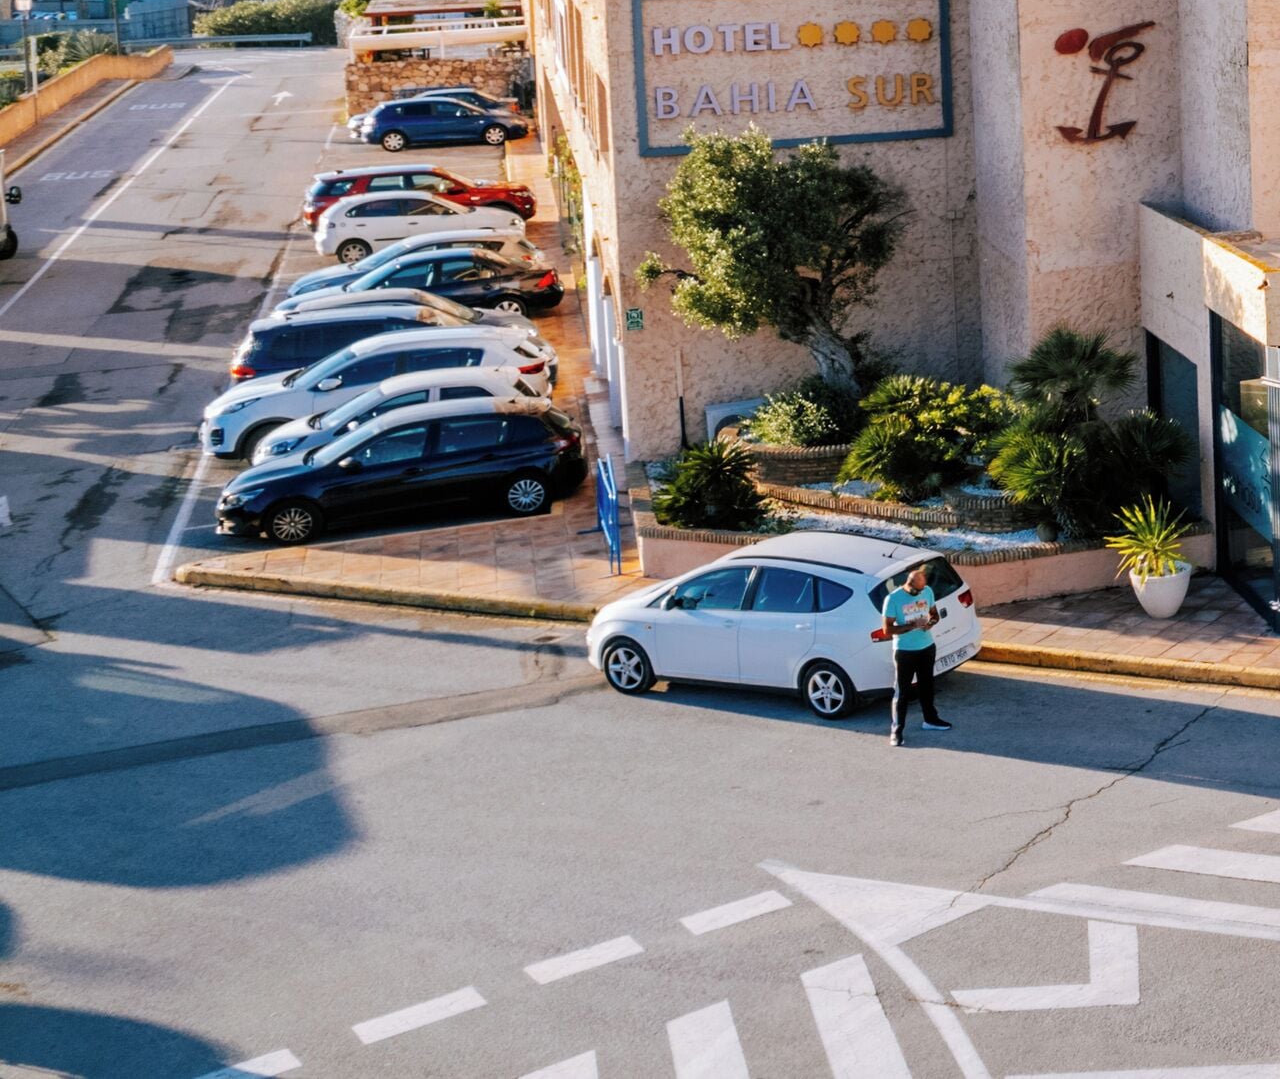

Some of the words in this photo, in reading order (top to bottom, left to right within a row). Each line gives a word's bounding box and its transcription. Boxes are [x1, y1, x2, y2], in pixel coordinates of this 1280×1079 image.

[653, 23, 791, 57] HOTEL
[128, 102, 187, 111] BUS
[656, 79, 818, 120] BAHIA
[847, 73, 935, 110] SUR
[40, 170, 114, 181] BUS
